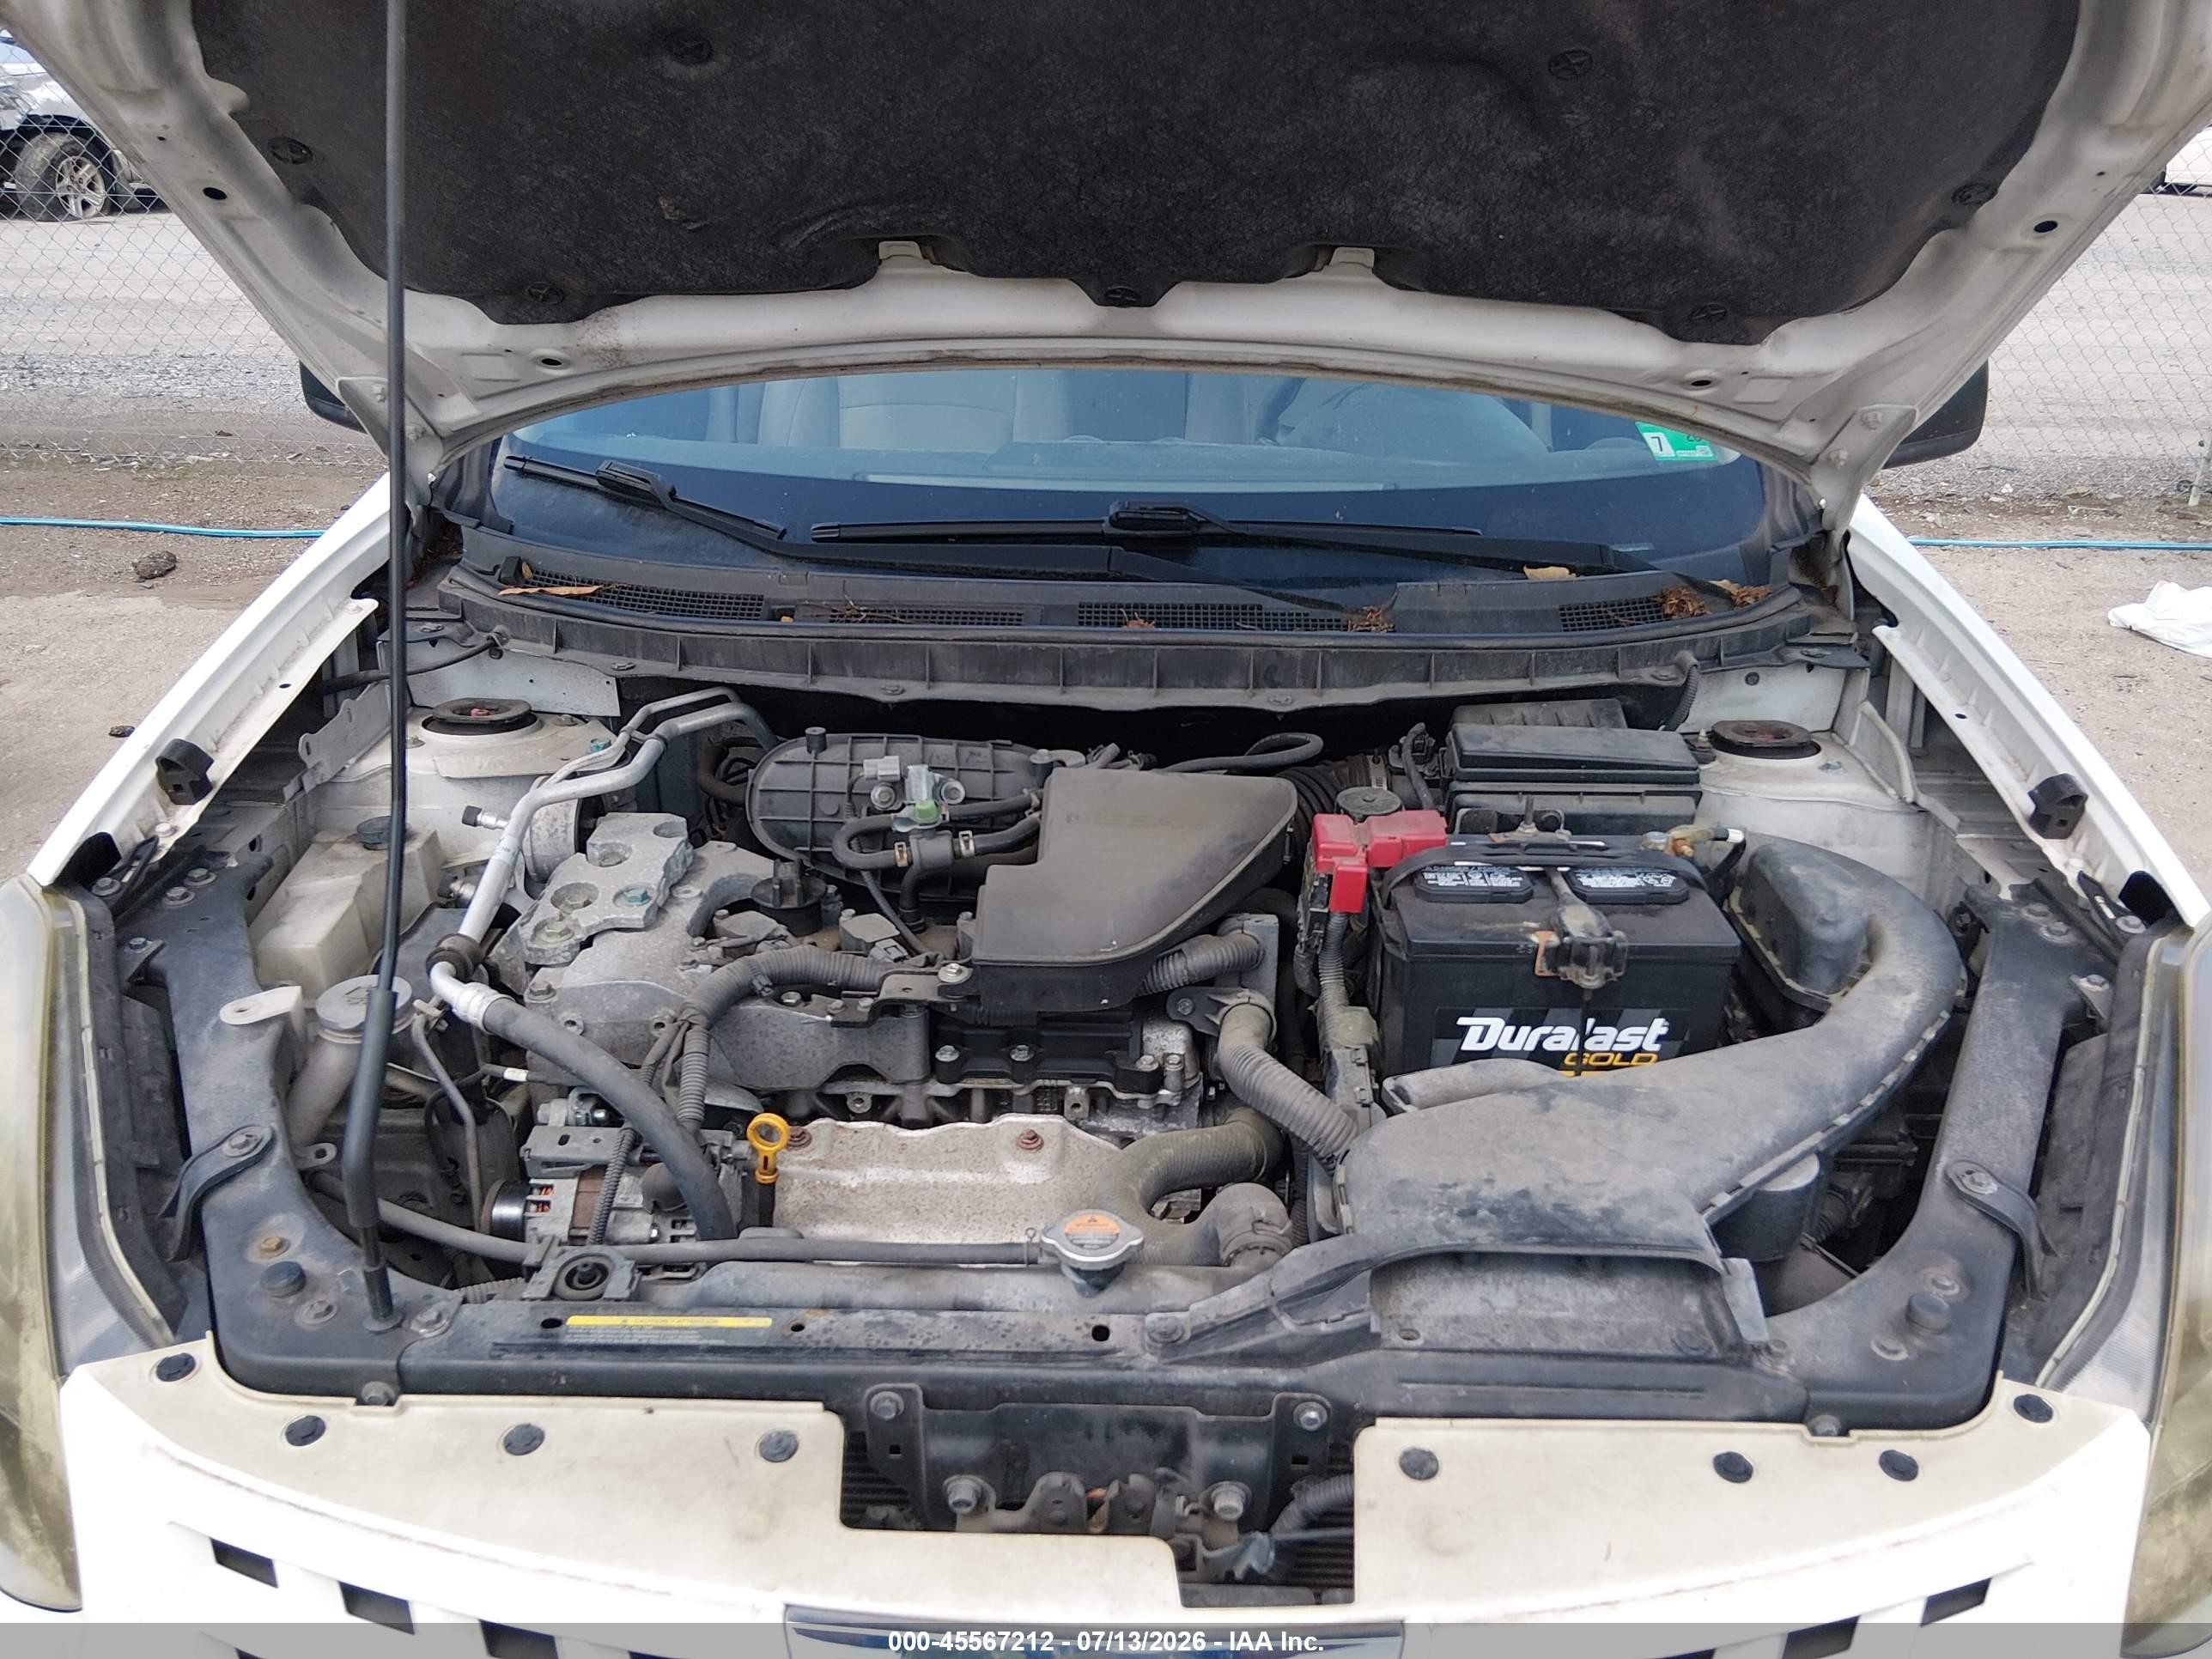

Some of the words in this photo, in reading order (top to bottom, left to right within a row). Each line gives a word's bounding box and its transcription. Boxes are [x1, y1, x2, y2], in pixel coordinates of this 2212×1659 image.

[1650, 436, 1663, 452] 7
[1456, 1017, 1669, 1051] Duralast
[1564, 1052, 1658, 1066] GOLD
